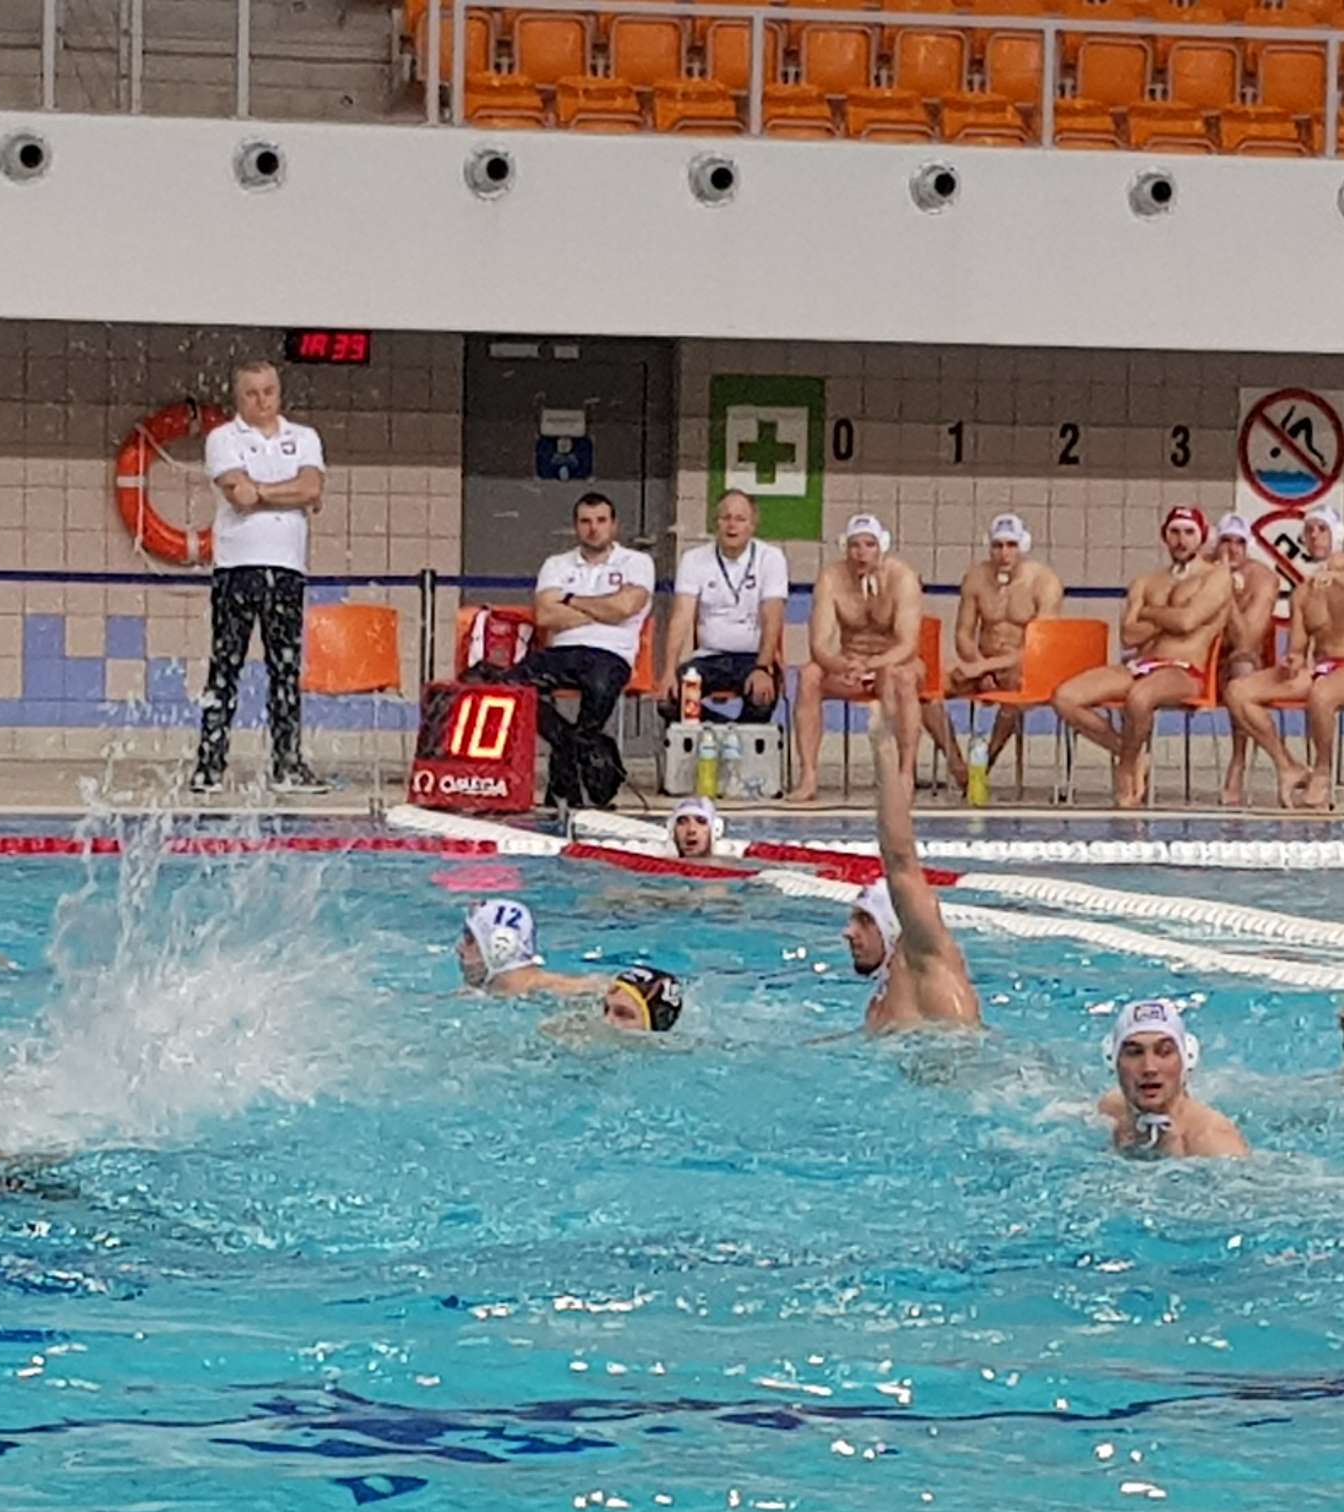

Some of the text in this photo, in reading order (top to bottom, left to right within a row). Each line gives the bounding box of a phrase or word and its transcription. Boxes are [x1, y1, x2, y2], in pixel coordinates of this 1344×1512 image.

[832, 418, 854, 461] 0
[948, 420, 964, 464] 1
[1058, 423, 1080, 465] 2
[1170, 424, 1191, 467] 3
[450, 694, 516, 759] 10
[493, 905, 523, 930] 12
